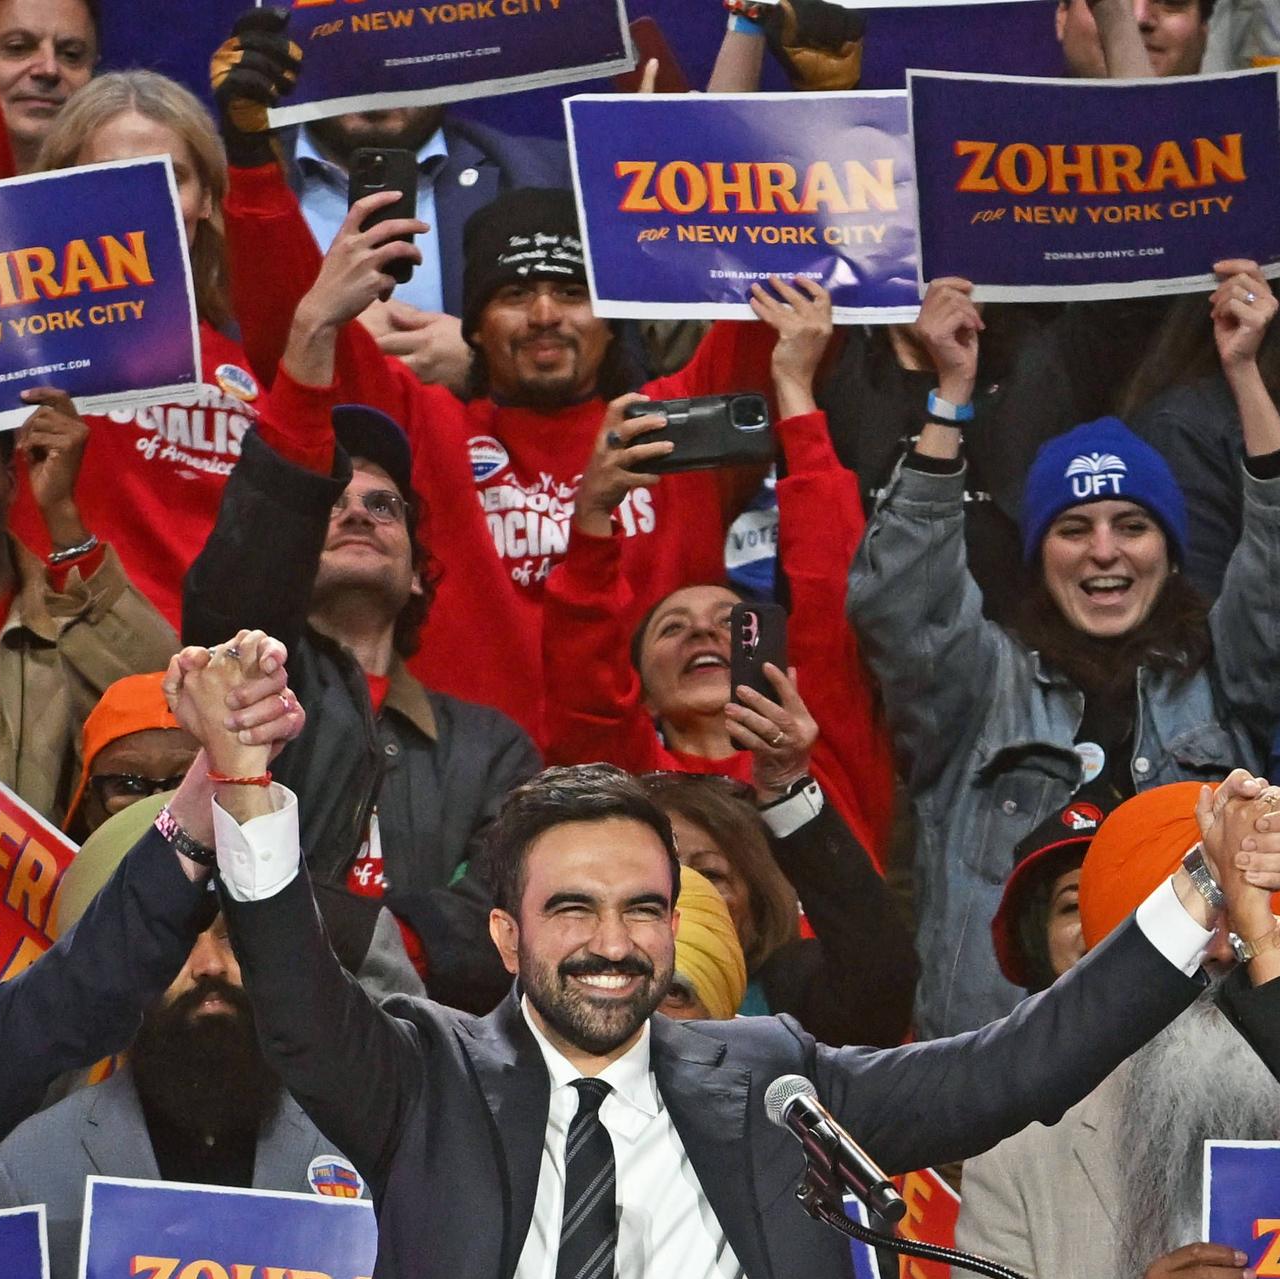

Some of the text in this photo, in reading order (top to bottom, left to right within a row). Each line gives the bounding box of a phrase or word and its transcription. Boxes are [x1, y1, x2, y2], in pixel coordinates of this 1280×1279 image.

[310, 19, 344, 39] FOR
[352, 8, 421, 32] NEW
[420, 1, 495, 25] YORK
[384, 46, 501, 67] ZOHRANFORNYC.COM
[954, 133, 1248, 194] ZOHRAN
[615, 157, 901, 214] ZOHRAN
[971, 196, 1233, 225] FOR NEW YORK CITY
[637, 225, 886, 245] FOR NEW YORK CITY
[1043, 247, 1164, 261] ZOHRANFORNYC.COM
[8, 309, 85, 340] YORK
[89, 300, 146, 328] CITY
[136, 436, 161, 460] of
[1072, 473, 1125, 498] UFT
[511, 560, 534, 587] of
